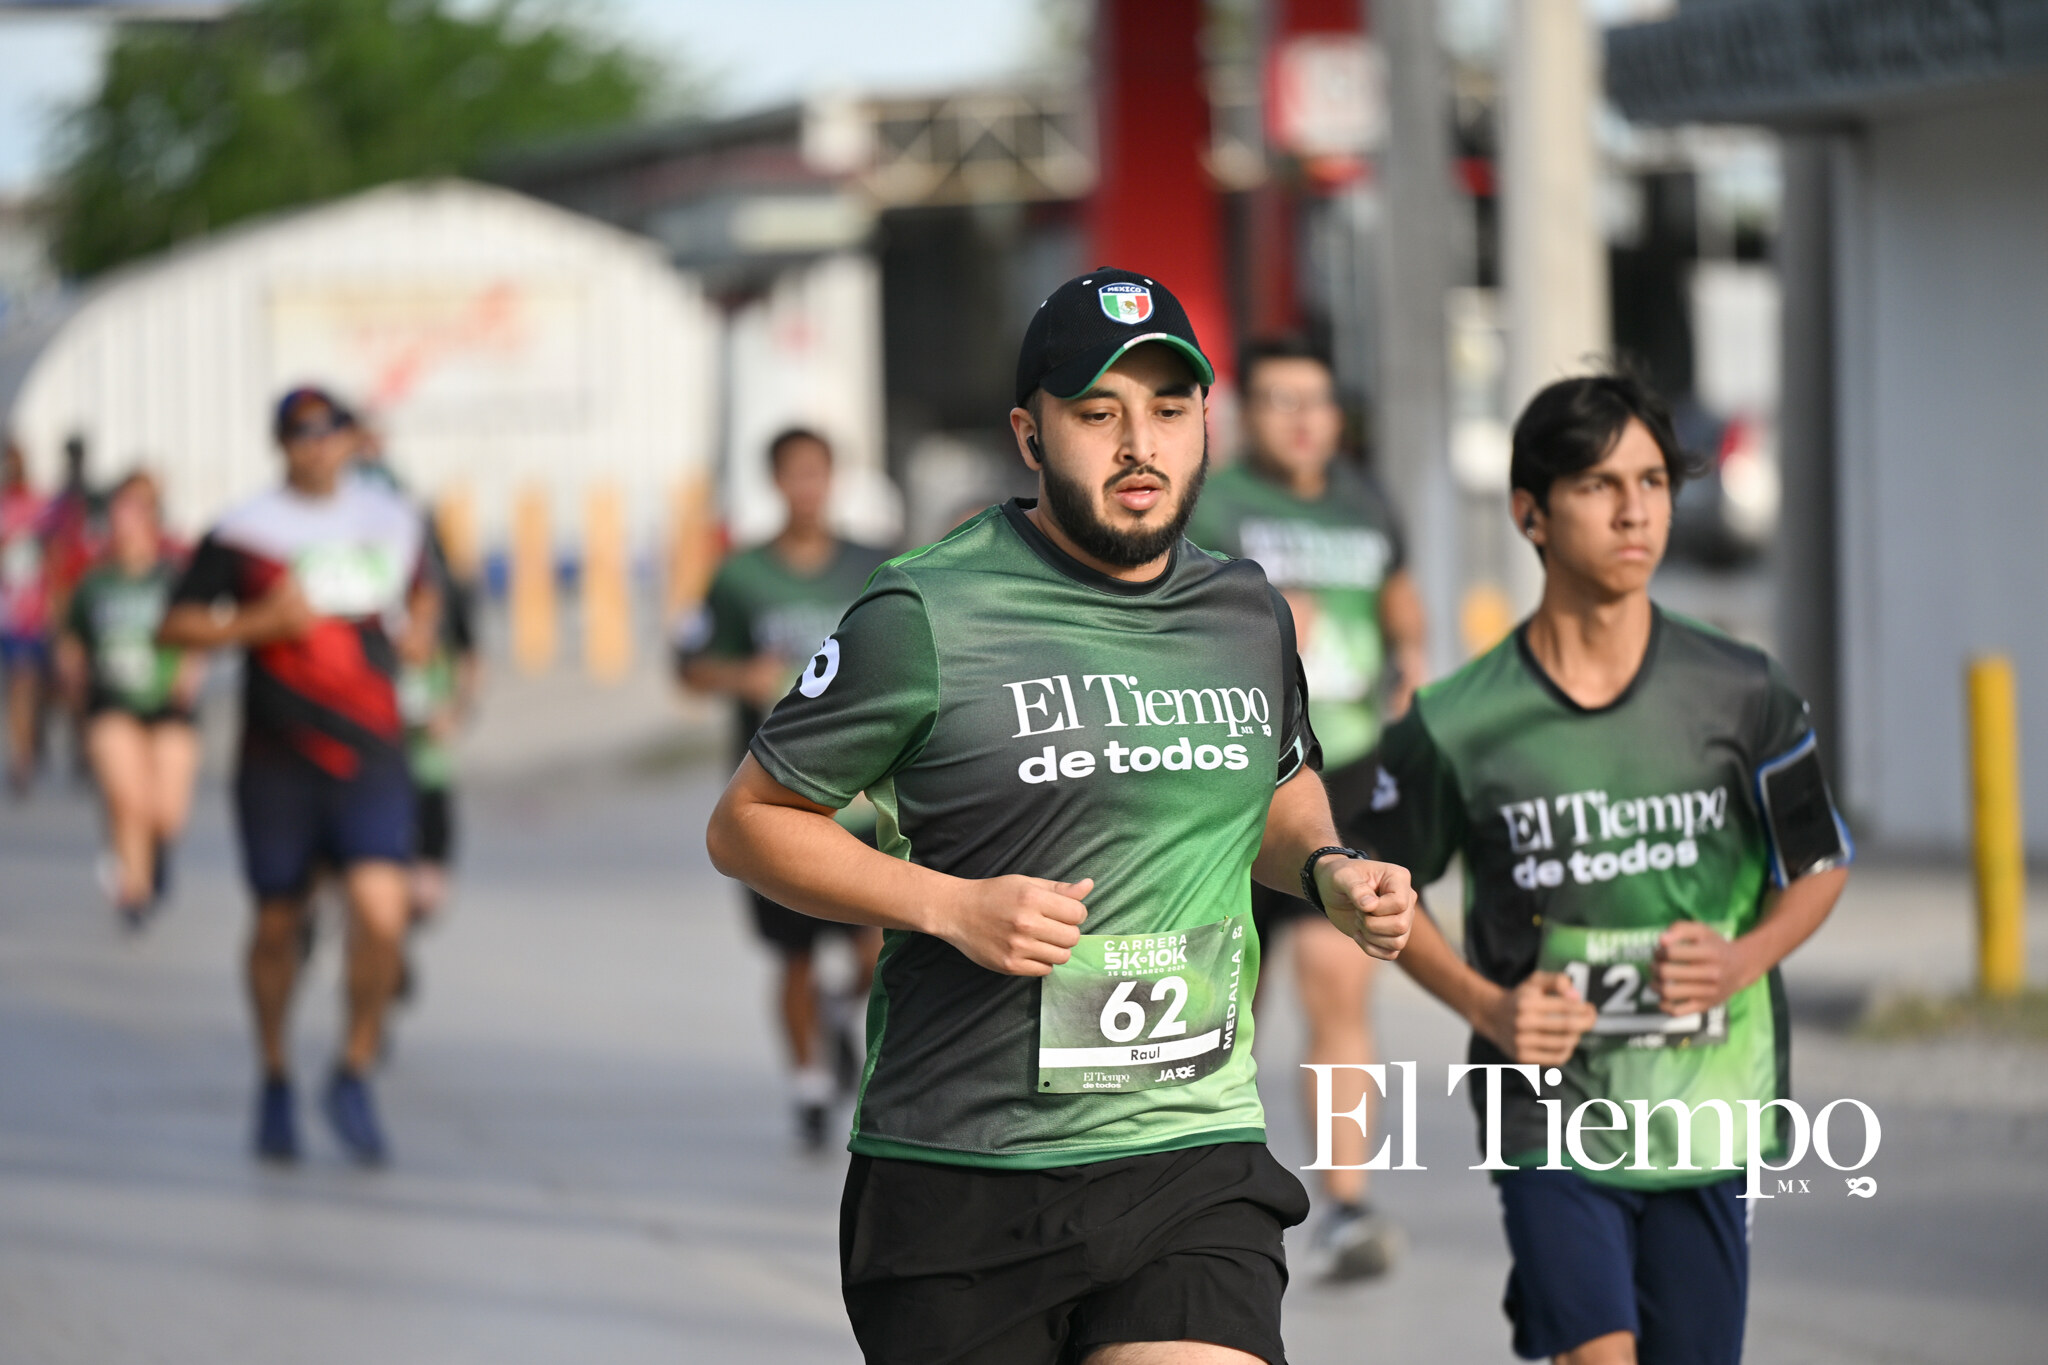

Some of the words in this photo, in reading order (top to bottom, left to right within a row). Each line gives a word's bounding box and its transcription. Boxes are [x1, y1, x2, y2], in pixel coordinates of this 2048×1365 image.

[1002, 674, 1085, 738] El
[1083, 673, 1270, 738] Tiempo
[1018, 745, 1096, 785] de
[1103, 737, 1250, 774] todos
[1499, 797, 1553, 854] El
[1555, 786, 1728, 843] Tiempo
[1512, 855, 1564, 890] de
[1568, 838, 1699, 884] todos
[1103, 934, 1187, 952] CARRERA
[1100, 975, 1188, 1043] 62
[1222, 948, 1242, 1051] MEDALLA
[1232, 925, 1243, 940] 62
[1083, 1071, 1094, 1082] El
[1095, 1071, 1130, 1083] Tiempo
[1130, 1046, 1161, 1061] Raul
